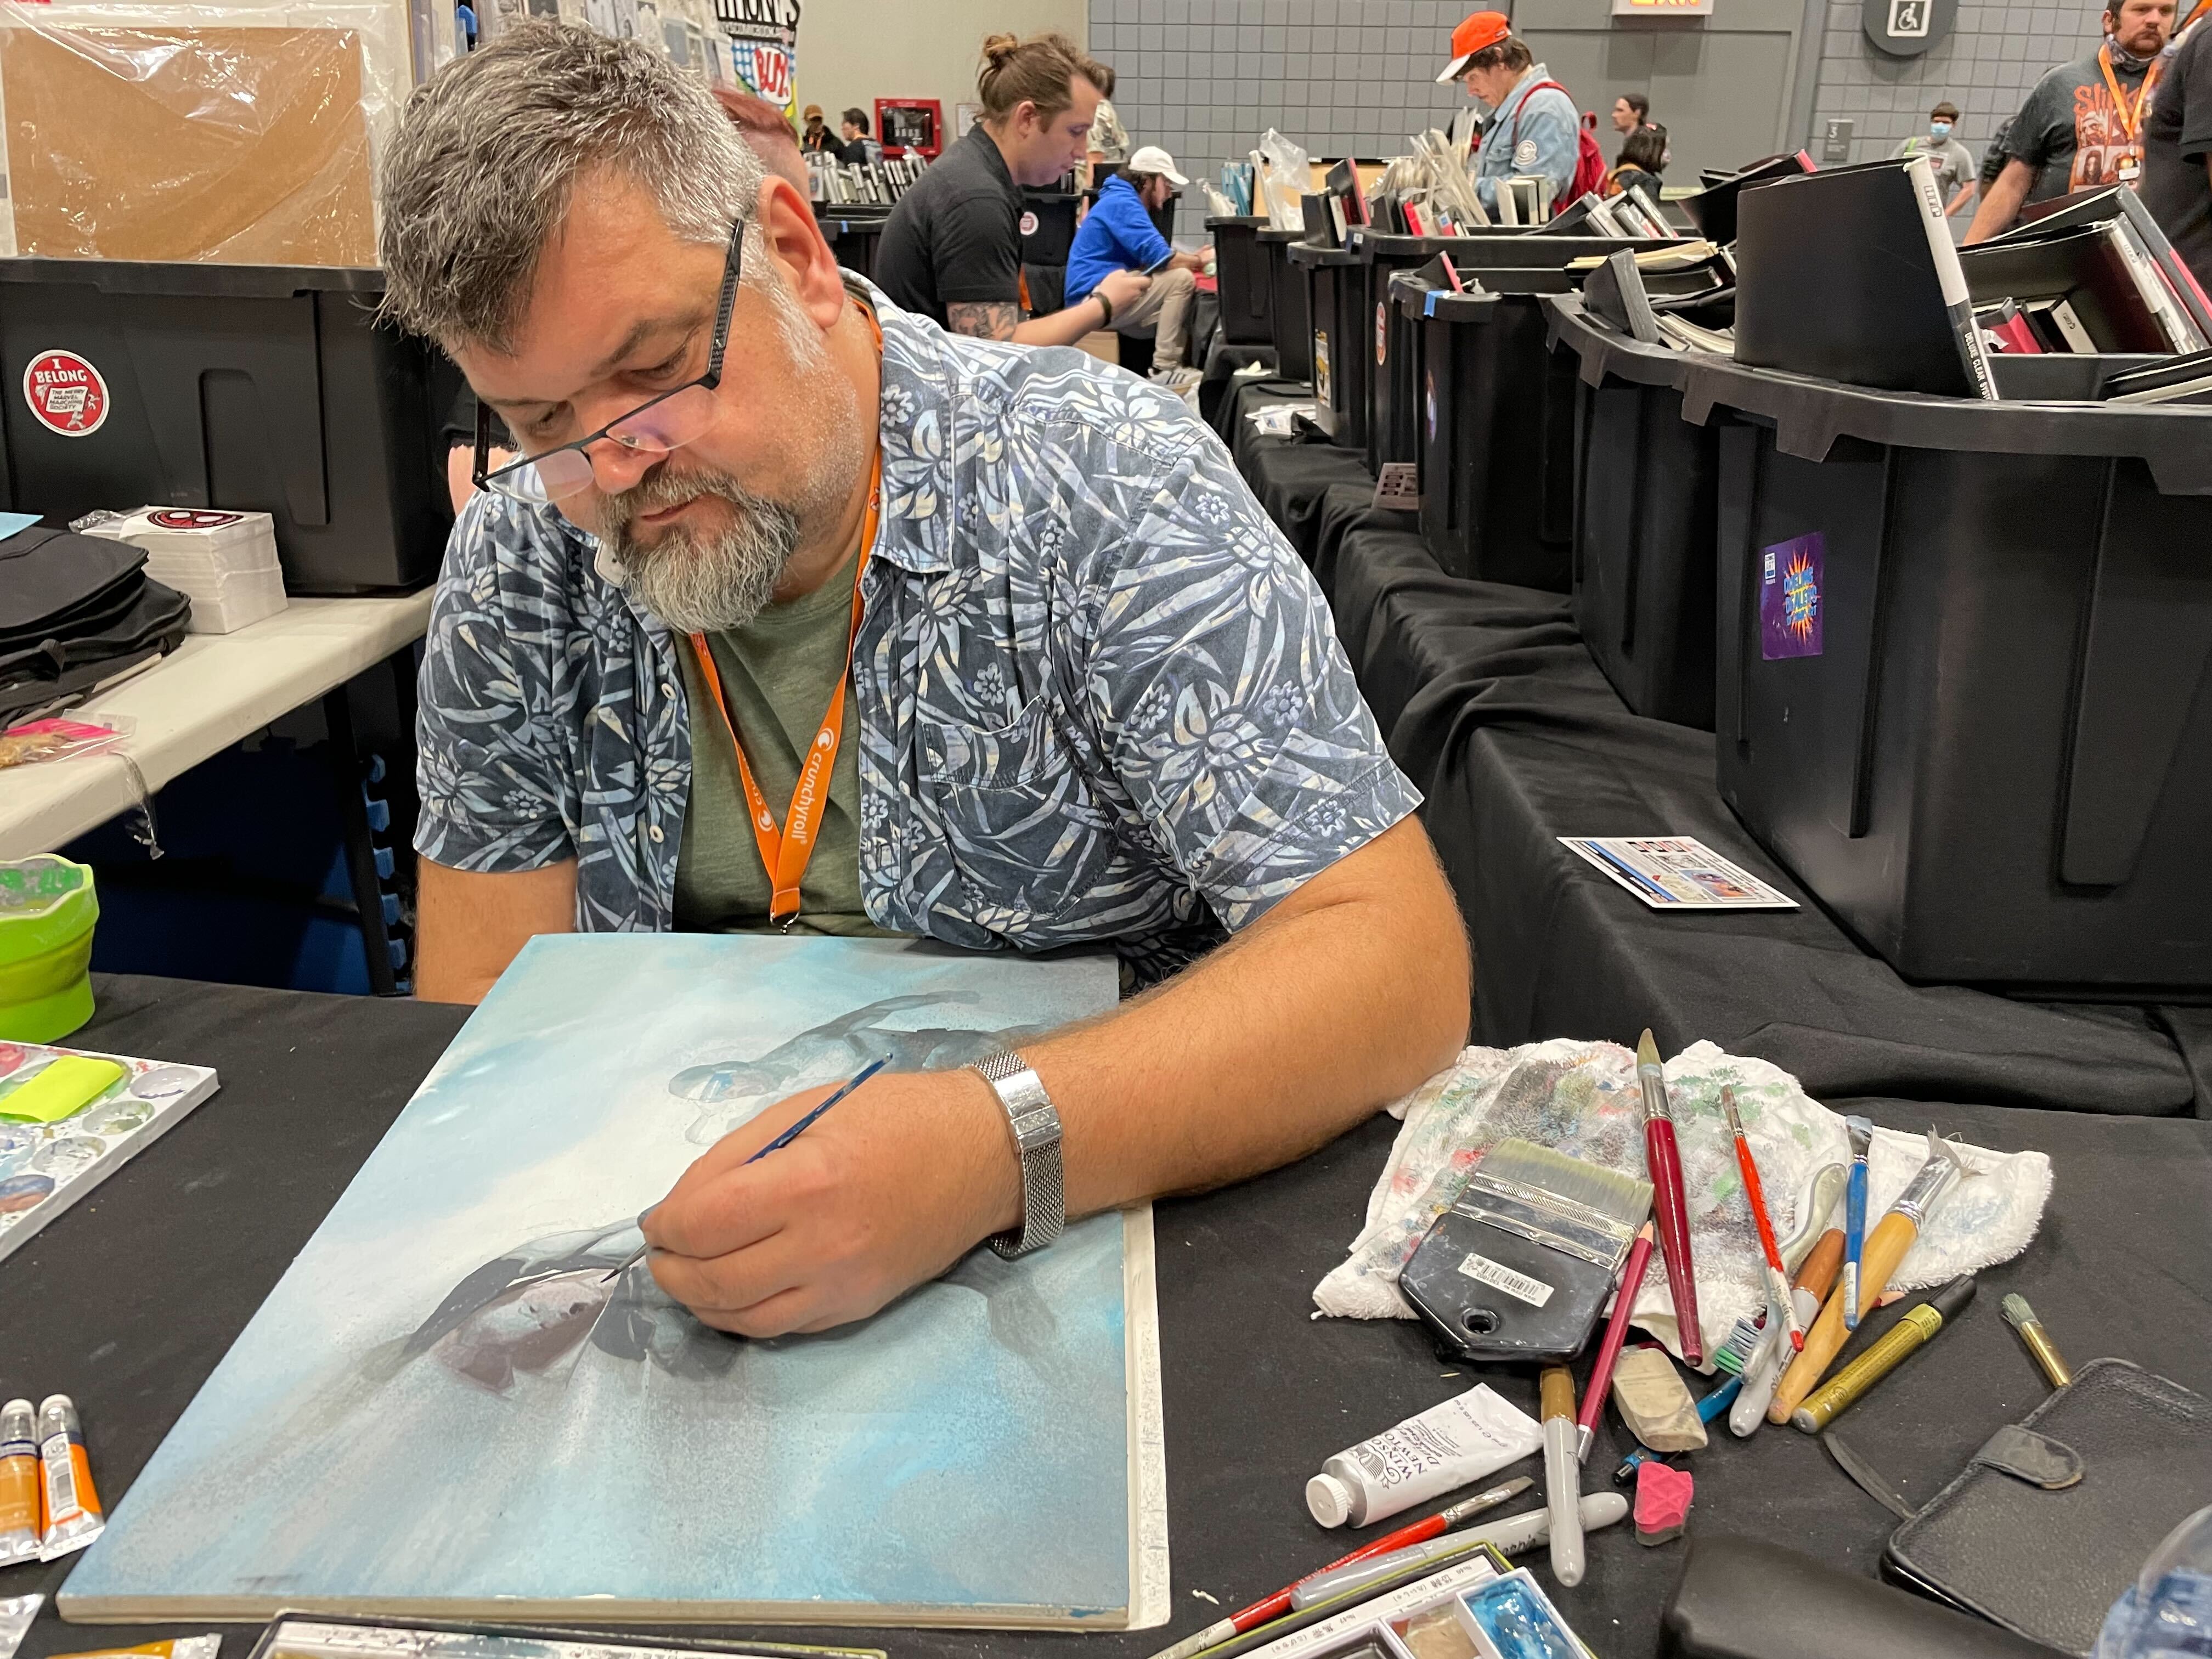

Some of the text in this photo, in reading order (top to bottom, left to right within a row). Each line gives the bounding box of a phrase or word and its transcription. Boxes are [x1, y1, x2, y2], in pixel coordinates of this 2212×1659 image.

[35, 369, 87, 383] BELONG
[52, 358, 61, 369] I
[1965, 331, 1992, 400] DELUXE CLEAR SYST
[792, 752, 822, 839] crunchyroll
[1372, 1438, 1412, 1480] WINSO
[1385, 1433, 1427, 1475] NEWTO
